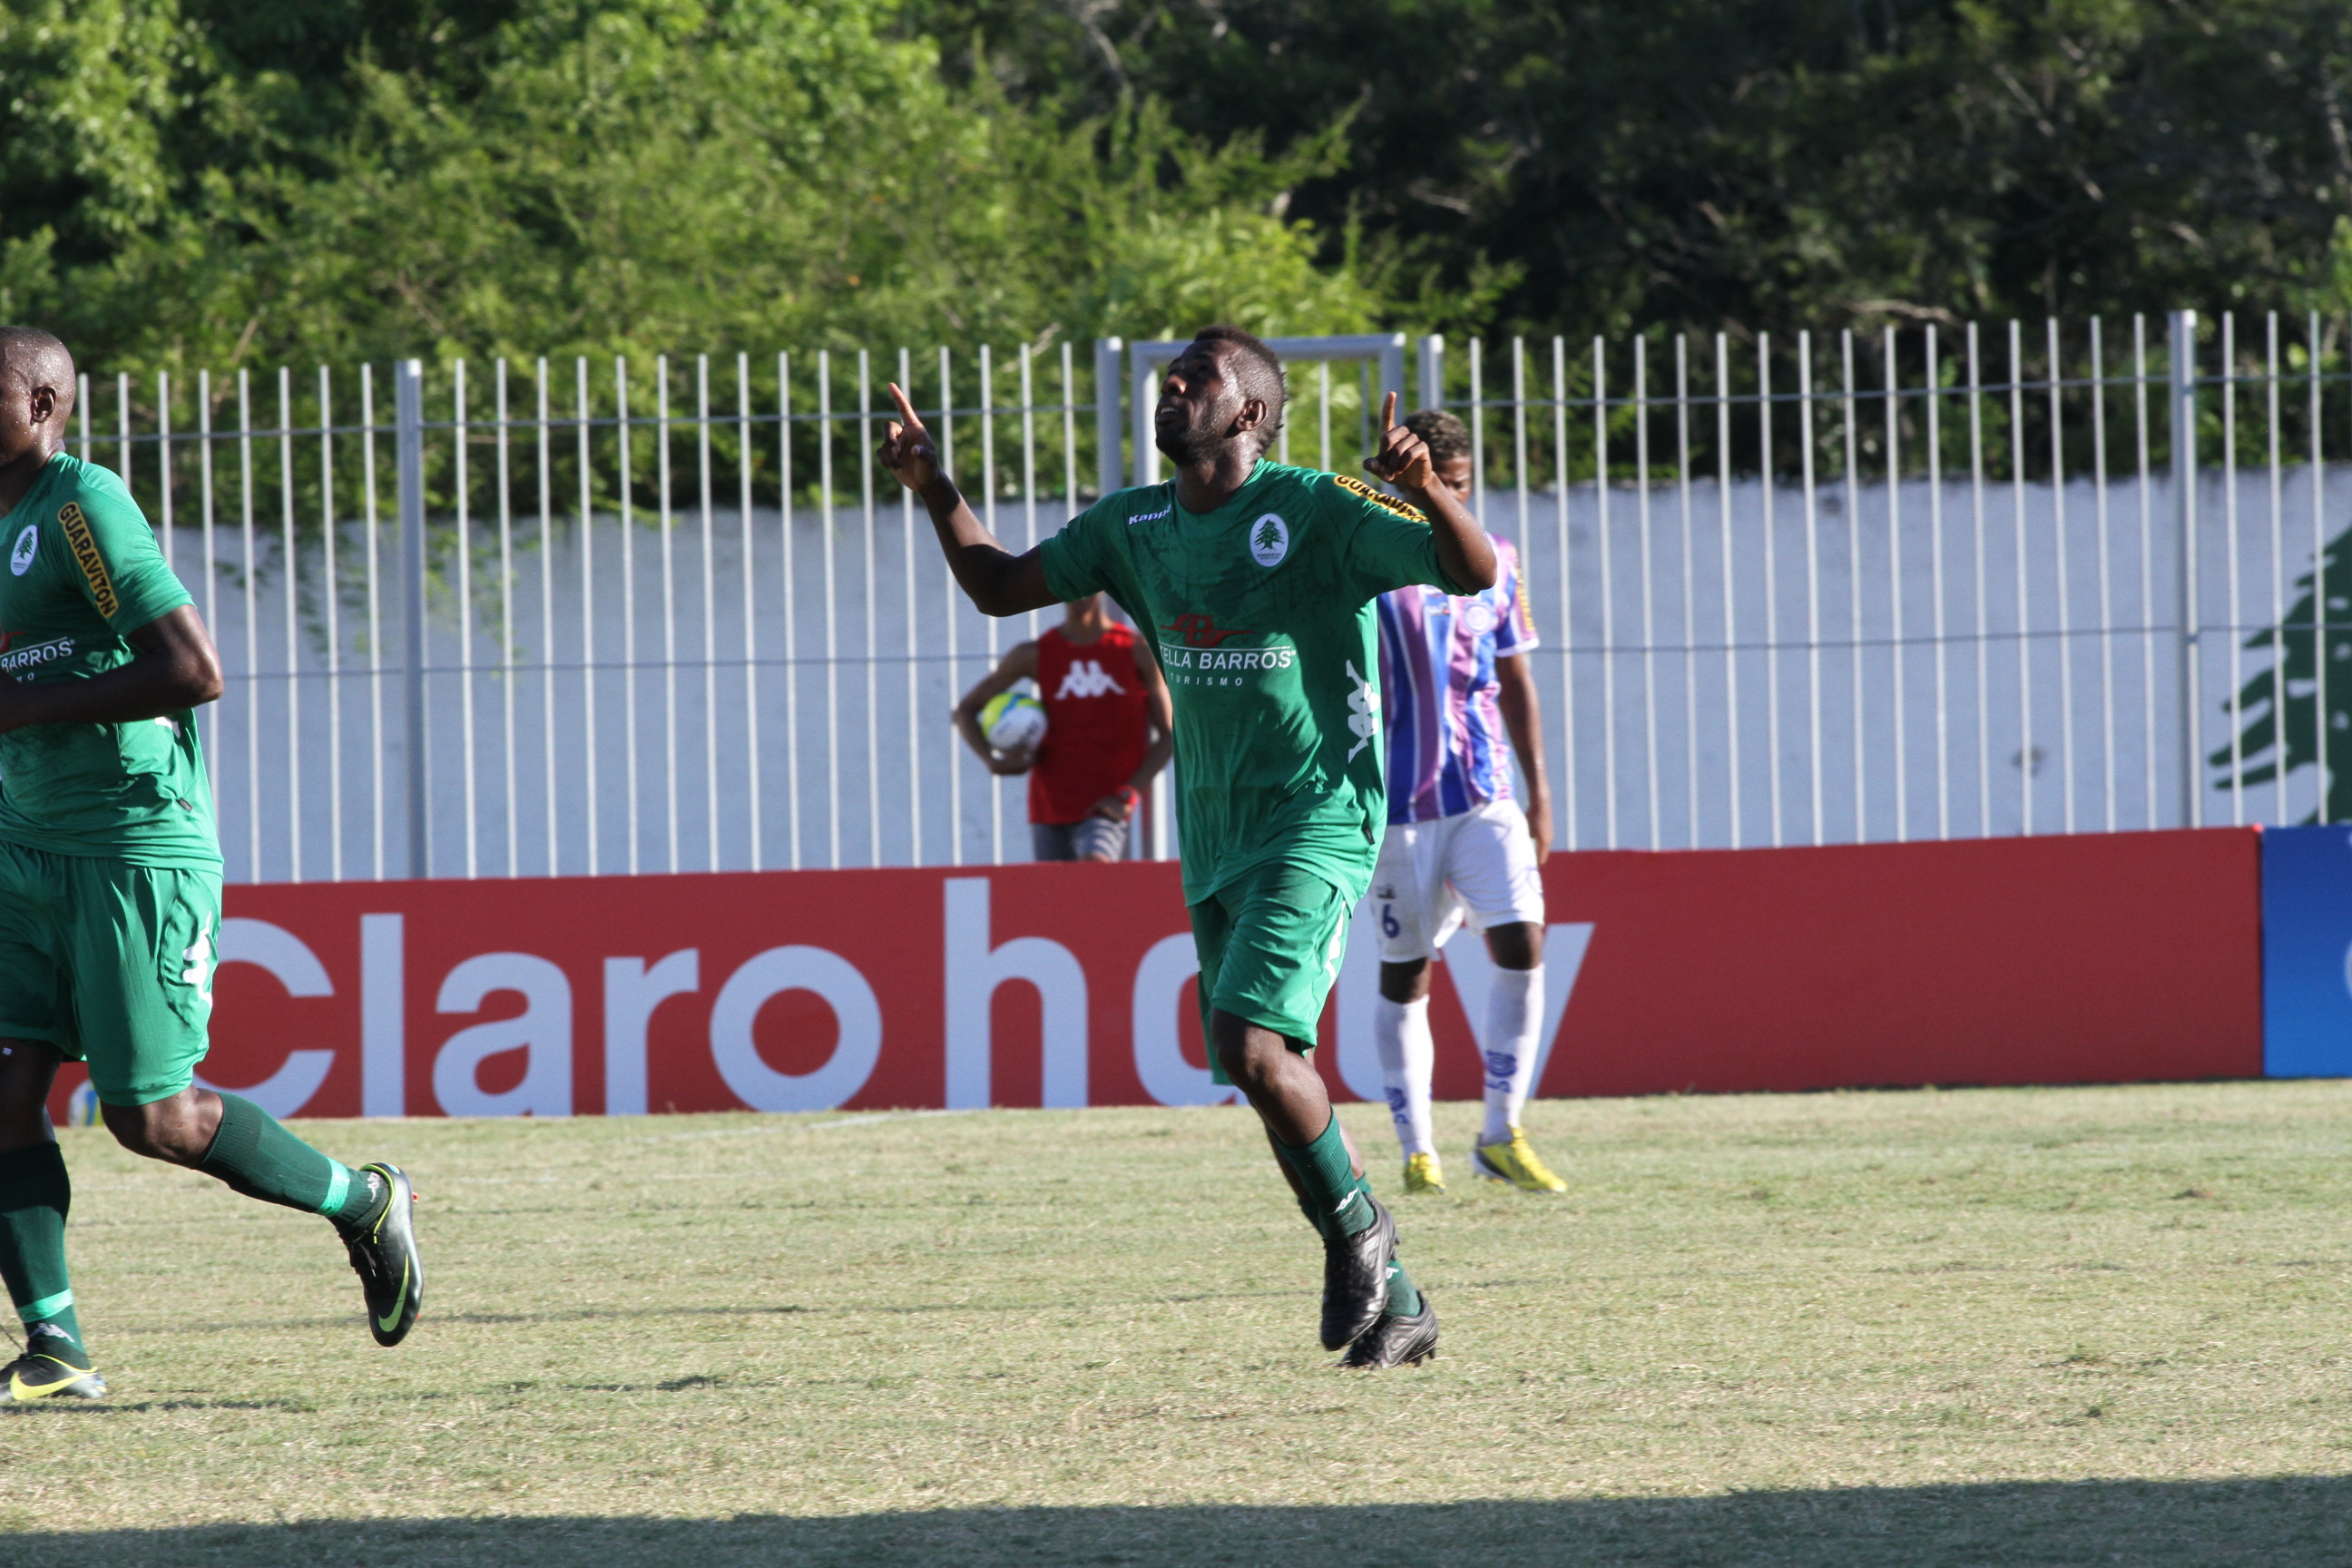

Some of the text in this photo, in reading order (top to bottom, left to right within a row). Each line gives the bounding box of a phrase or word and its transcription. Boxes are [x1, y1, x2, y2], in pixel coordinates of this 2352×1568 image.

[59, 503, 117, 617] GUARAVITON
[1159, 644, 1292, 671] TELLA BARROS
[1171, 672, 1243, 687] TURISMO
[1381, 903, 1401, 939] 6
[192, 912, 882, 1118] Claro
